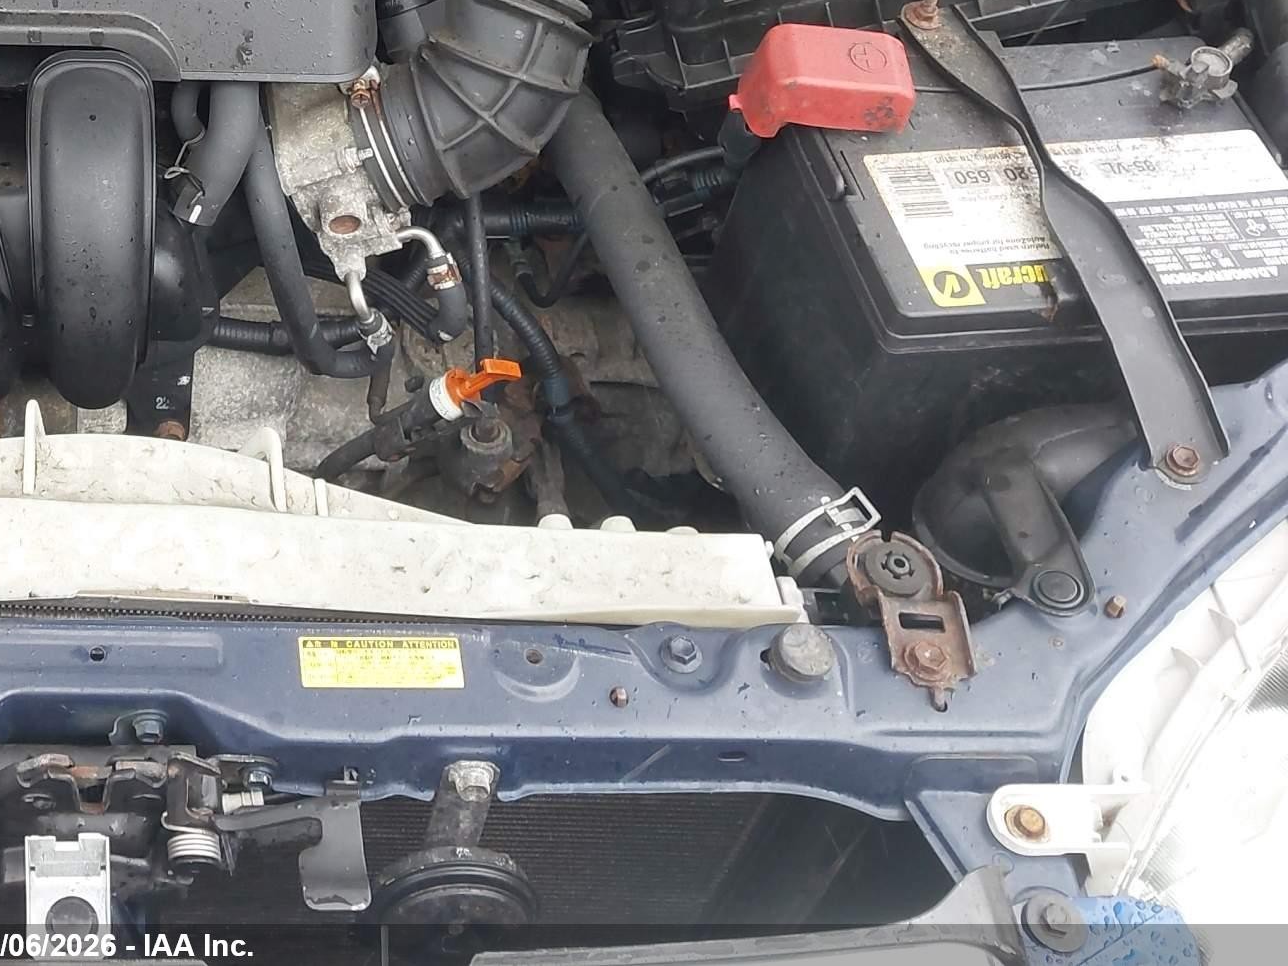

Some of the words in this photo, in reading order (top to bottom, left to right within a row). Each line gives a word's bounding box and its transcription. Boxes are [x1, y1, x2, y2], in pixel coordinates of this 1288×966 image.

[953, 168, 990, 185] 650
[976, 265, 1048, 289] ucraft
[345, 639, 394, 649] CAUTION
[401, 639, 455, 650] ATTENTION
